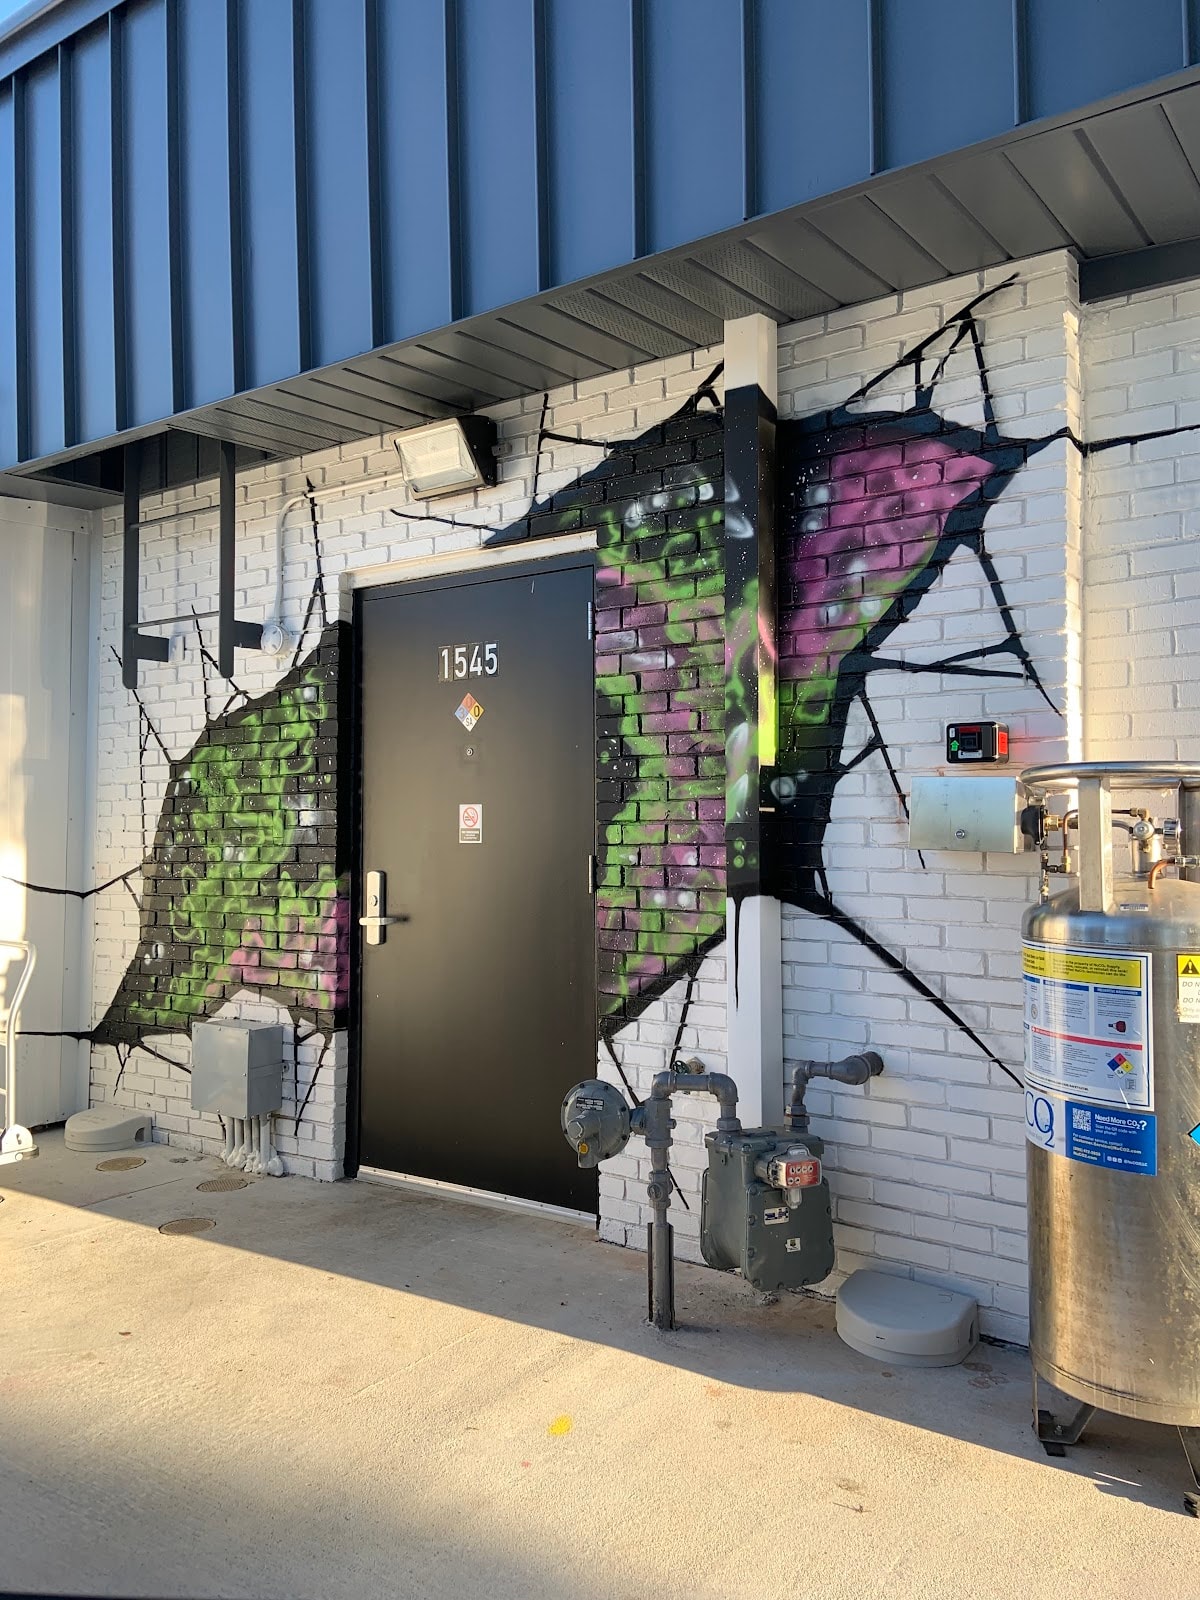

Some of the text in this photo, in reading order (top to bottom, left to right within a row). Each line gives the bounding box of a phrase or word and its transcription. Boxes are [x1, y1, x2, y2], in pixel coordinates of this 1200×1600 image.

[441, 643, 498, 679] 1545
[474, 705, 480, 717] 0
[465, 717, 473, 726] SA
[1094, 1113, 1110, 1122] Need
[1110, 1115, 1127, 1125] More
